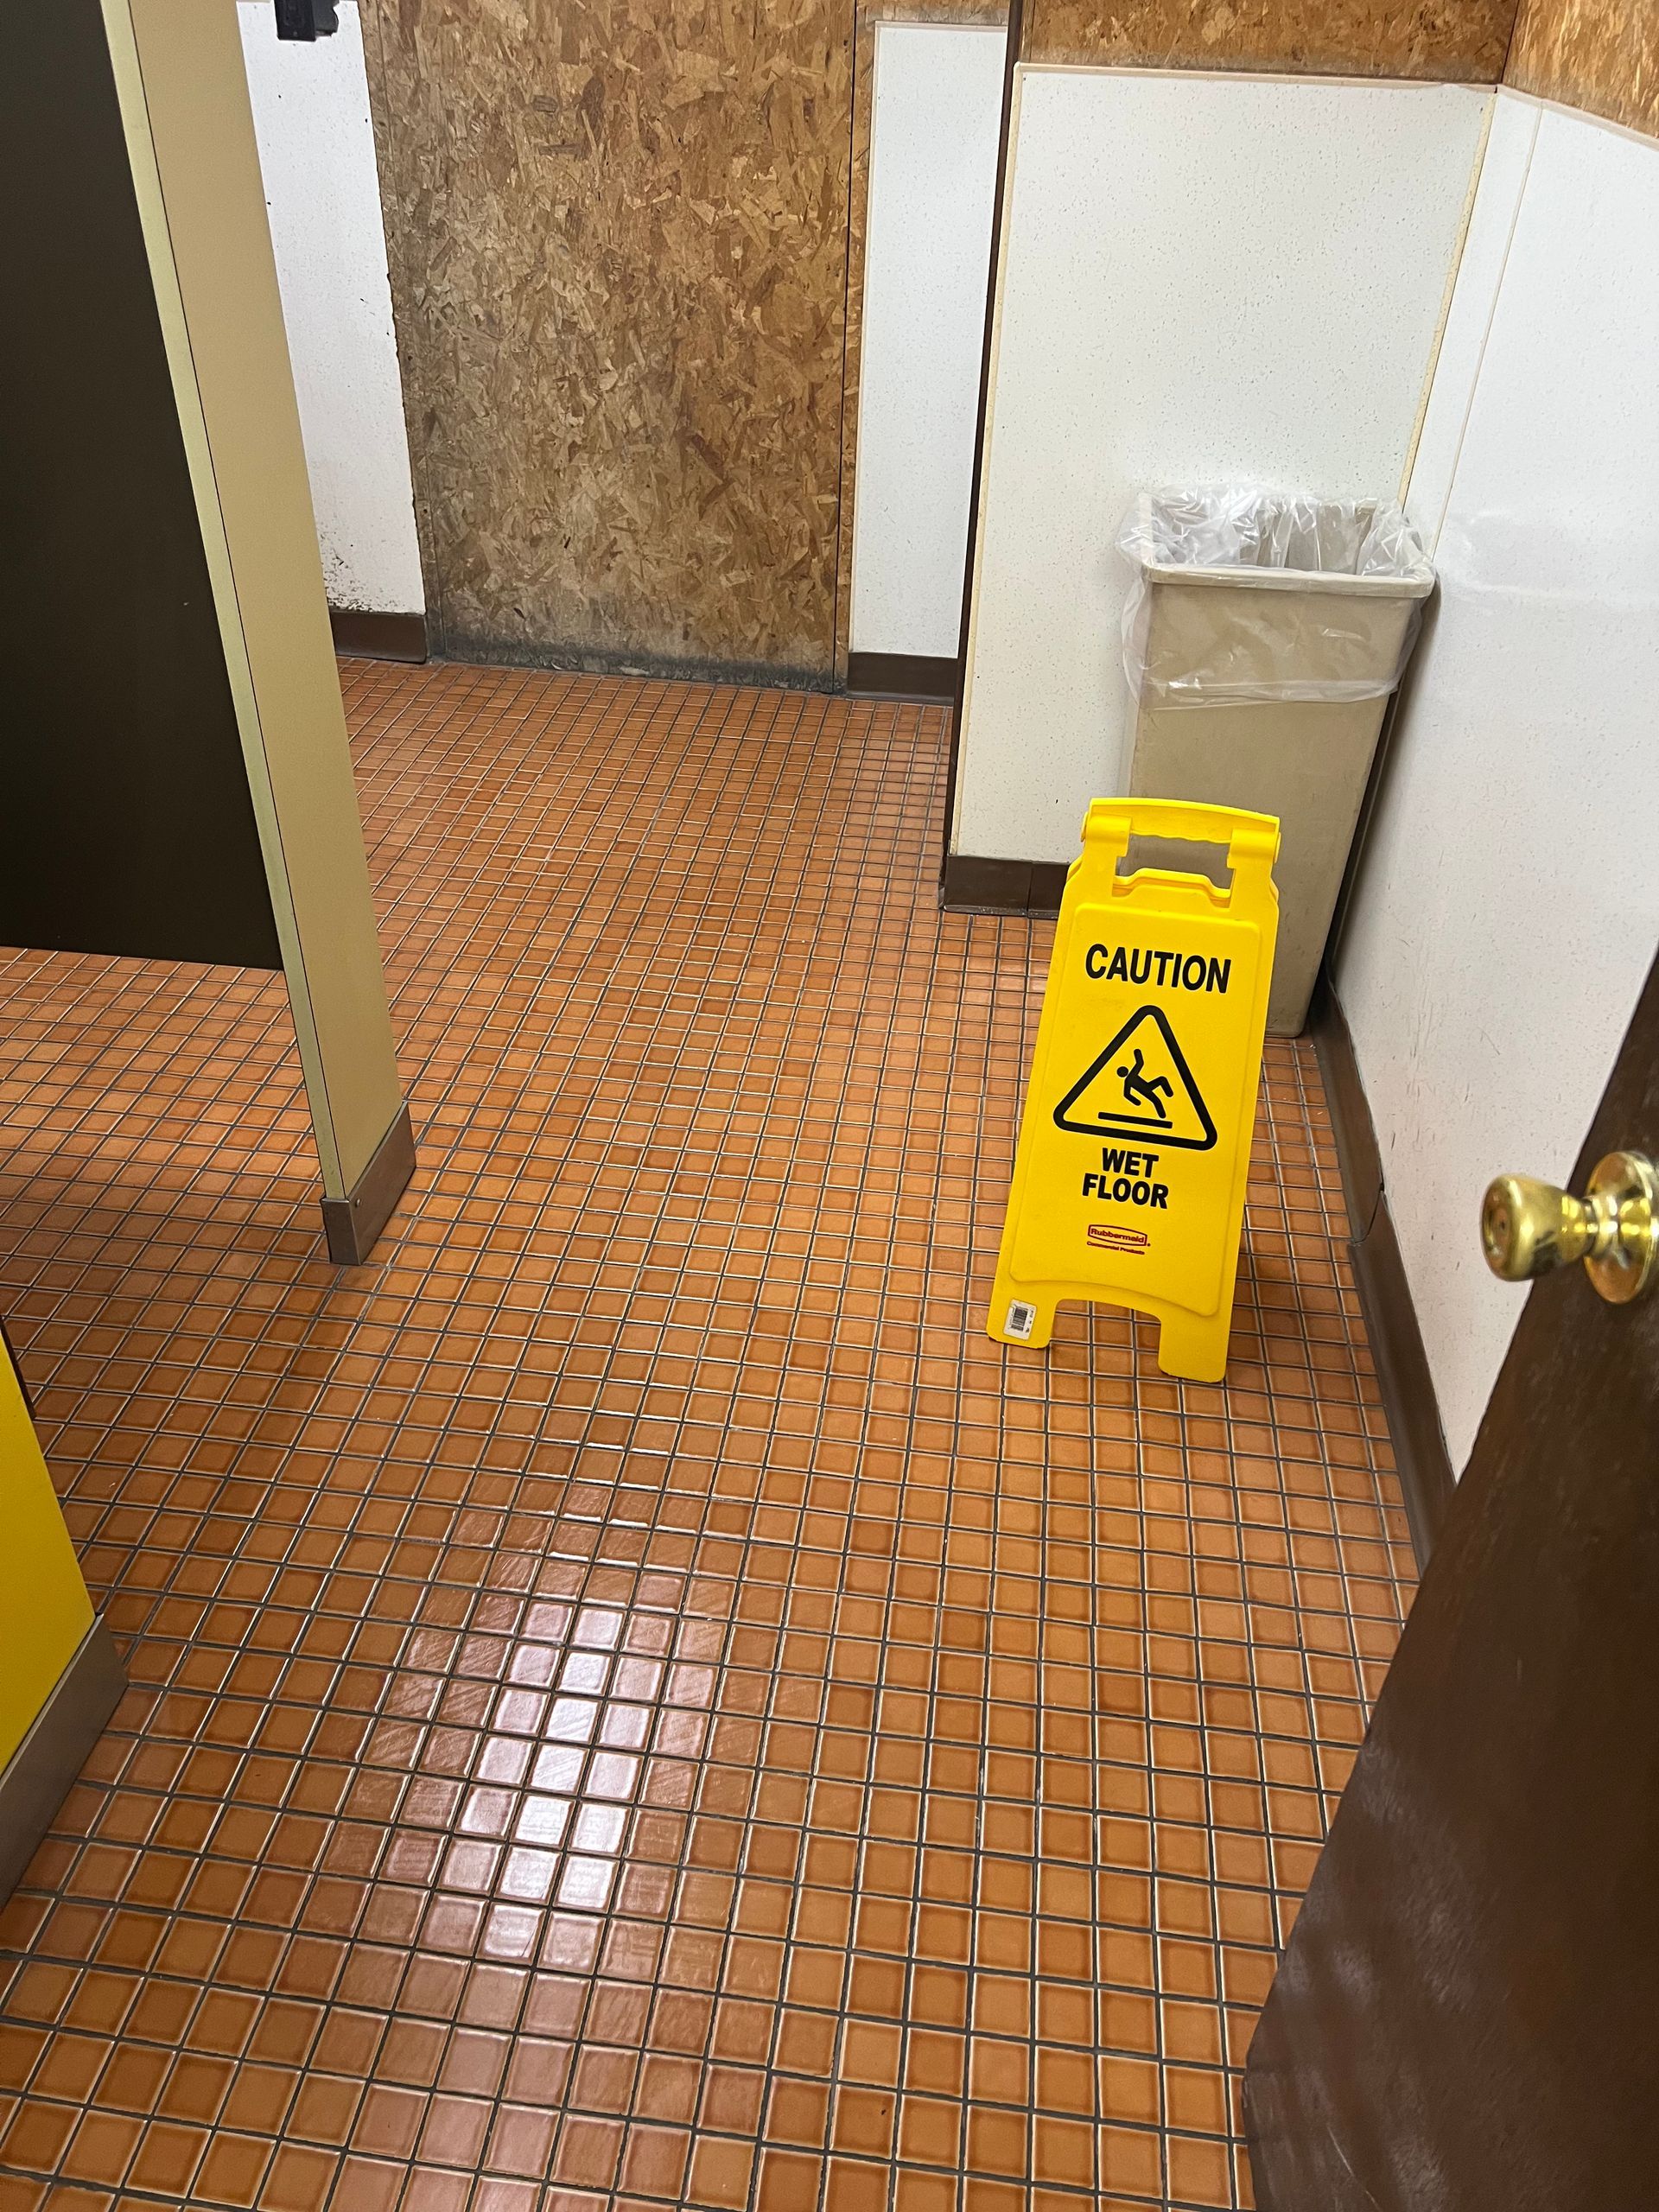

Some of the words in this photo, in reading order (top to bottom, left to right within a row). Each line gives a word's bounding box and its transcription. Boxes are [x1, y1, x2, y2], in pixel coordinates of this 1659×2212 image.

[1085, 944, 1231, 994] CAUTION
[1102, 1147, 1159, 1178] WET
[1082, 1173, 1169, 1209] FLOOR
[1090, 1228, 1145, 1243] Rubbermaid
